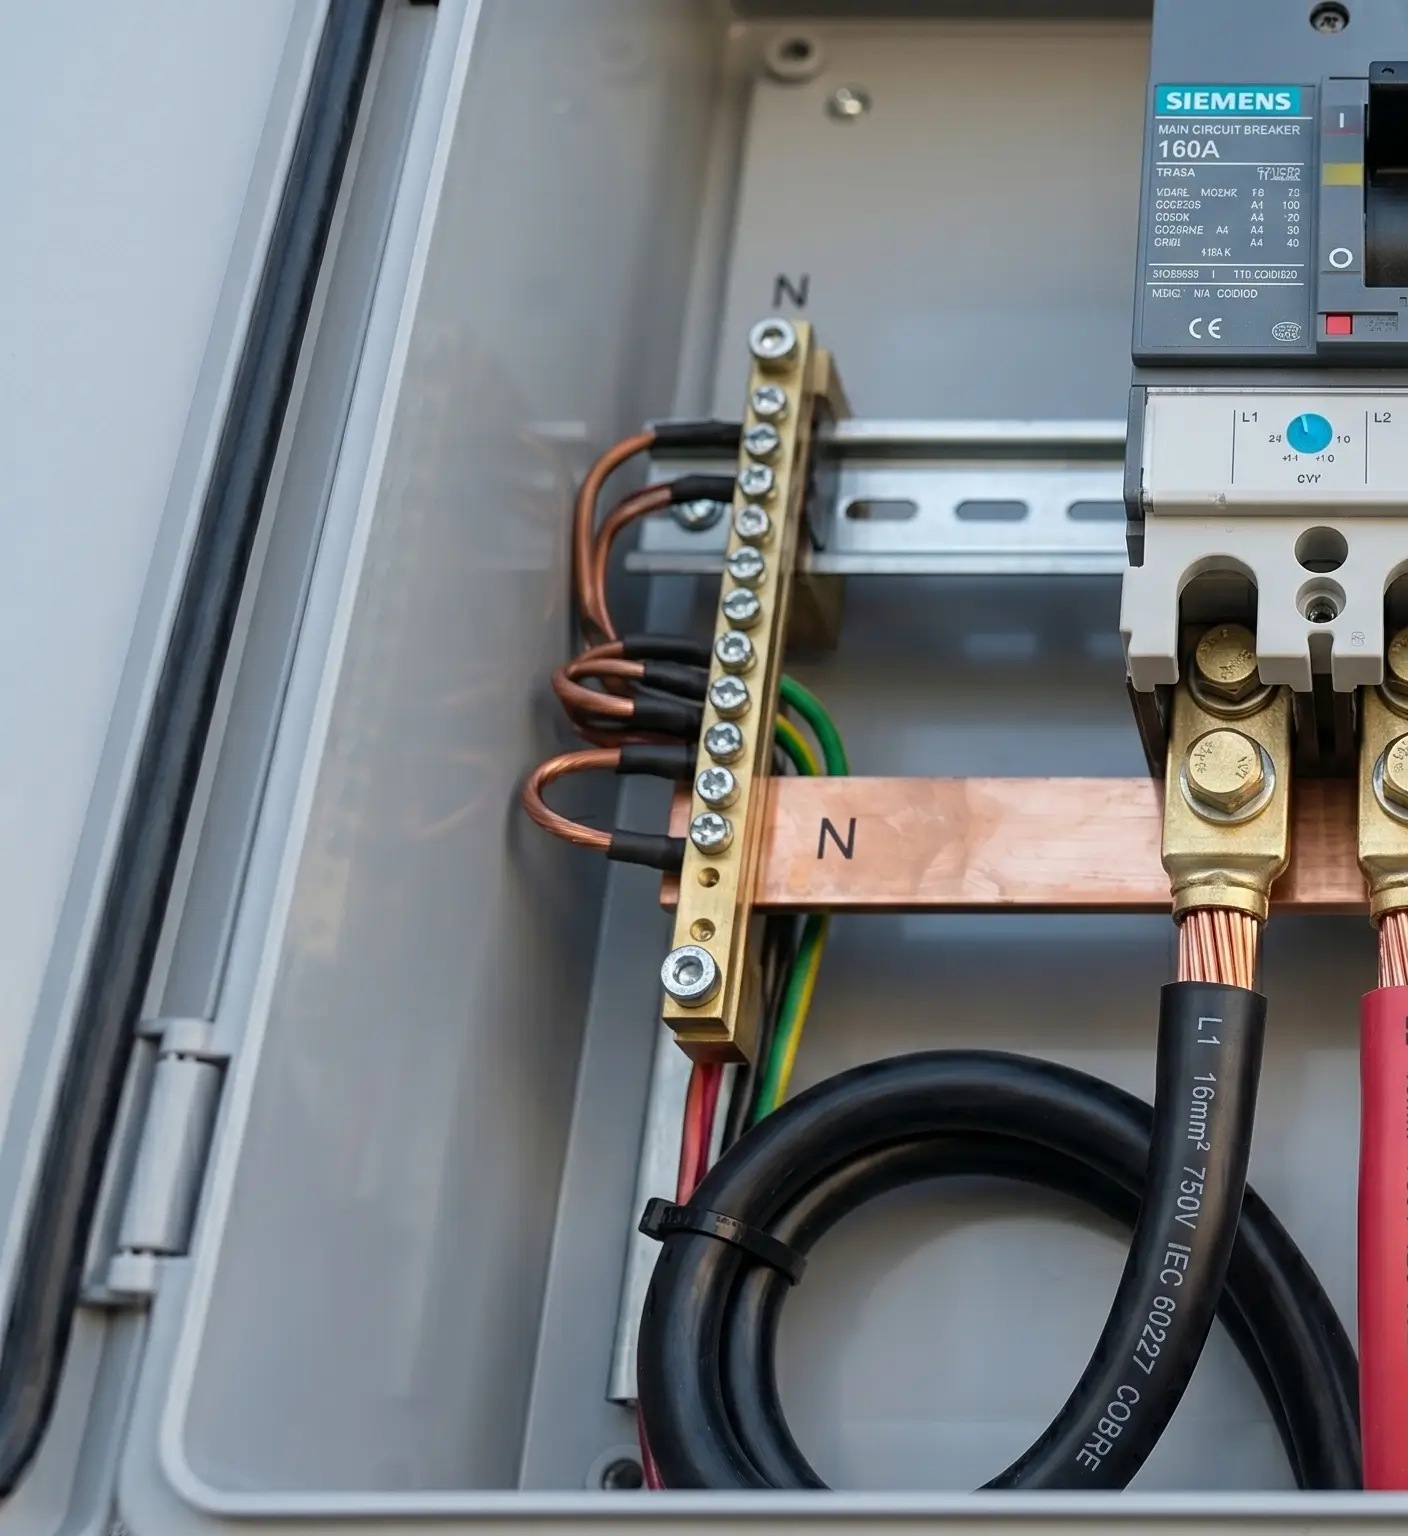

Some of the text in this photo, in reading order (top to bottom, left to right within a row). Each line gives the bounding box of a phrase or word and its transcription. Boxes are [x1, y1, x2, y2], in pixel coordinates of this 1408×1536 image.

[1166, 91, 1292, 111] SIEMENS
[1158, 124, 1301, 136] MAIN CIRCUIT BREAKER
[1158, 139, 1221, 159] 160A
[1156, 167, 1196, 178] TRASA
[1282, 200, 1300, 210] 100
[1286, 238, 1300, 248] 40
[771, 273, 811, 311] N
[1242, 411, 1259, 423] L1
[1374, 412, 1392, 424] L2
[817, 817, 857, 860] N
[1197, 1016, 1223, 1046] L1
[1174, 1166, 1207, 1230] 750V
[1159, 1241, 1192, 1287] IEC
[1132, 1295, 1176, 1375] 60227
[1075, 1384, 1141, 1472] COBRE
